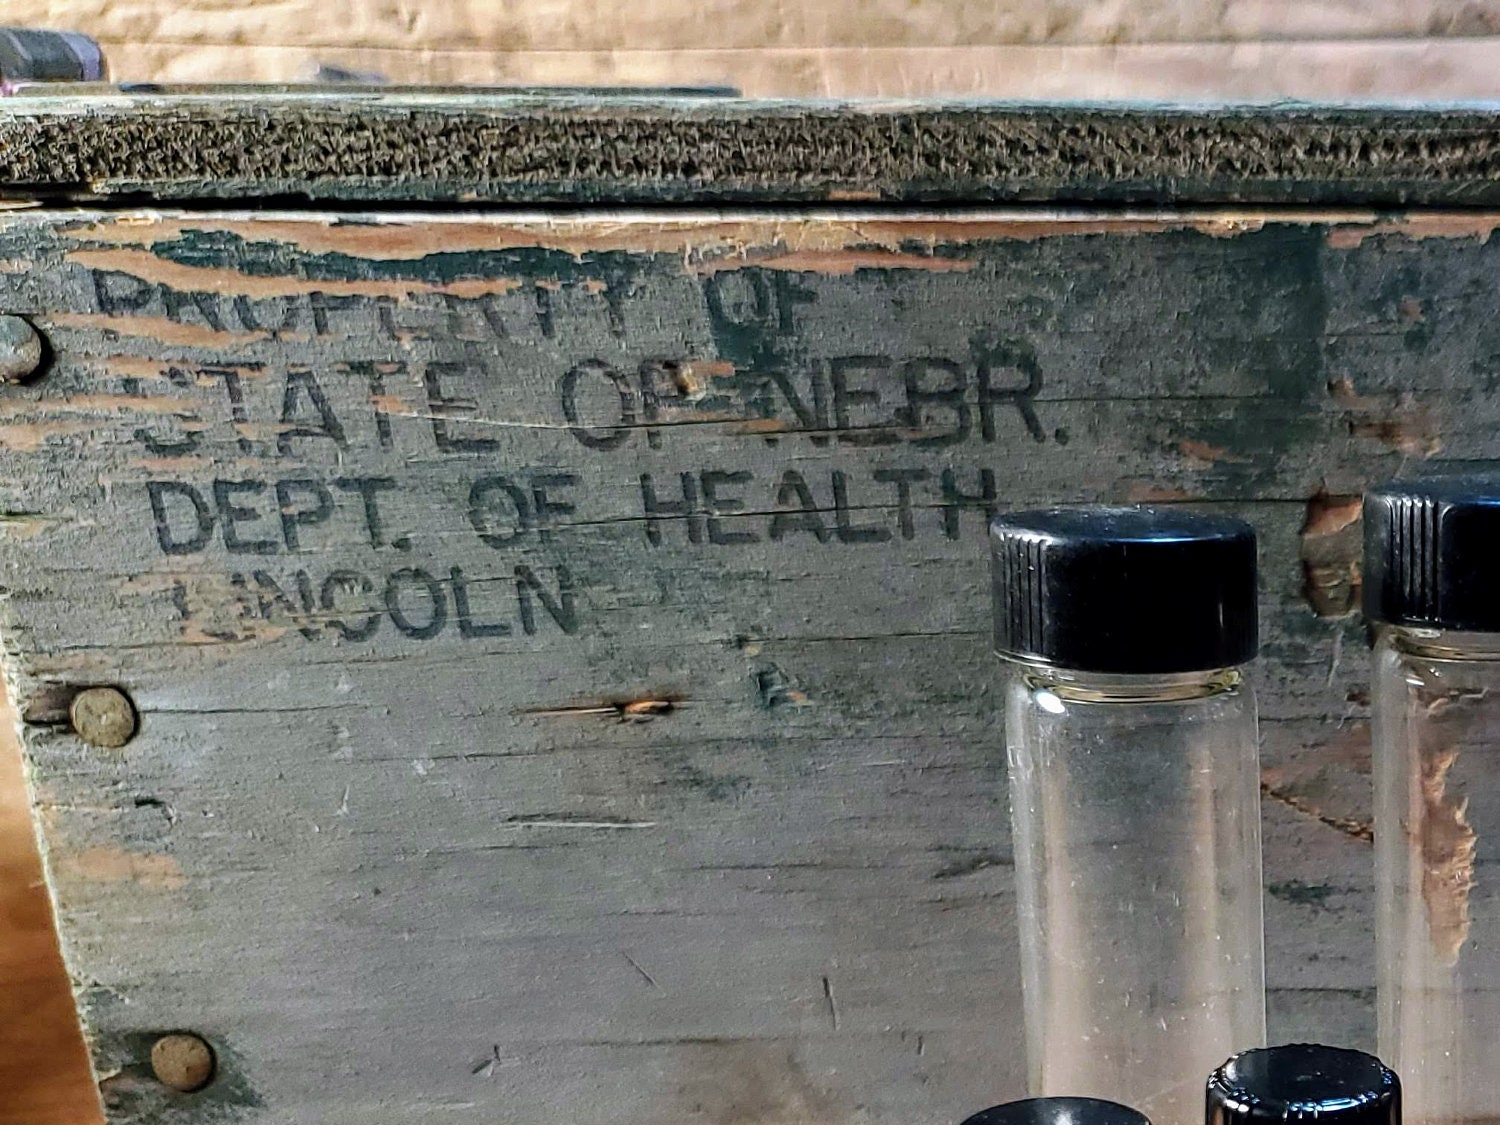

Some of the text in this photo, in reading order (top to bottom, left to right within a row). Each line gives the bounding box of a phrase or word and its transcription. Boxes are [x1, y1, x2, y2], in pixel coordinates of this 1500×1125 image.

[147, 468, 998, 555] DEPT. OF HEALTH
